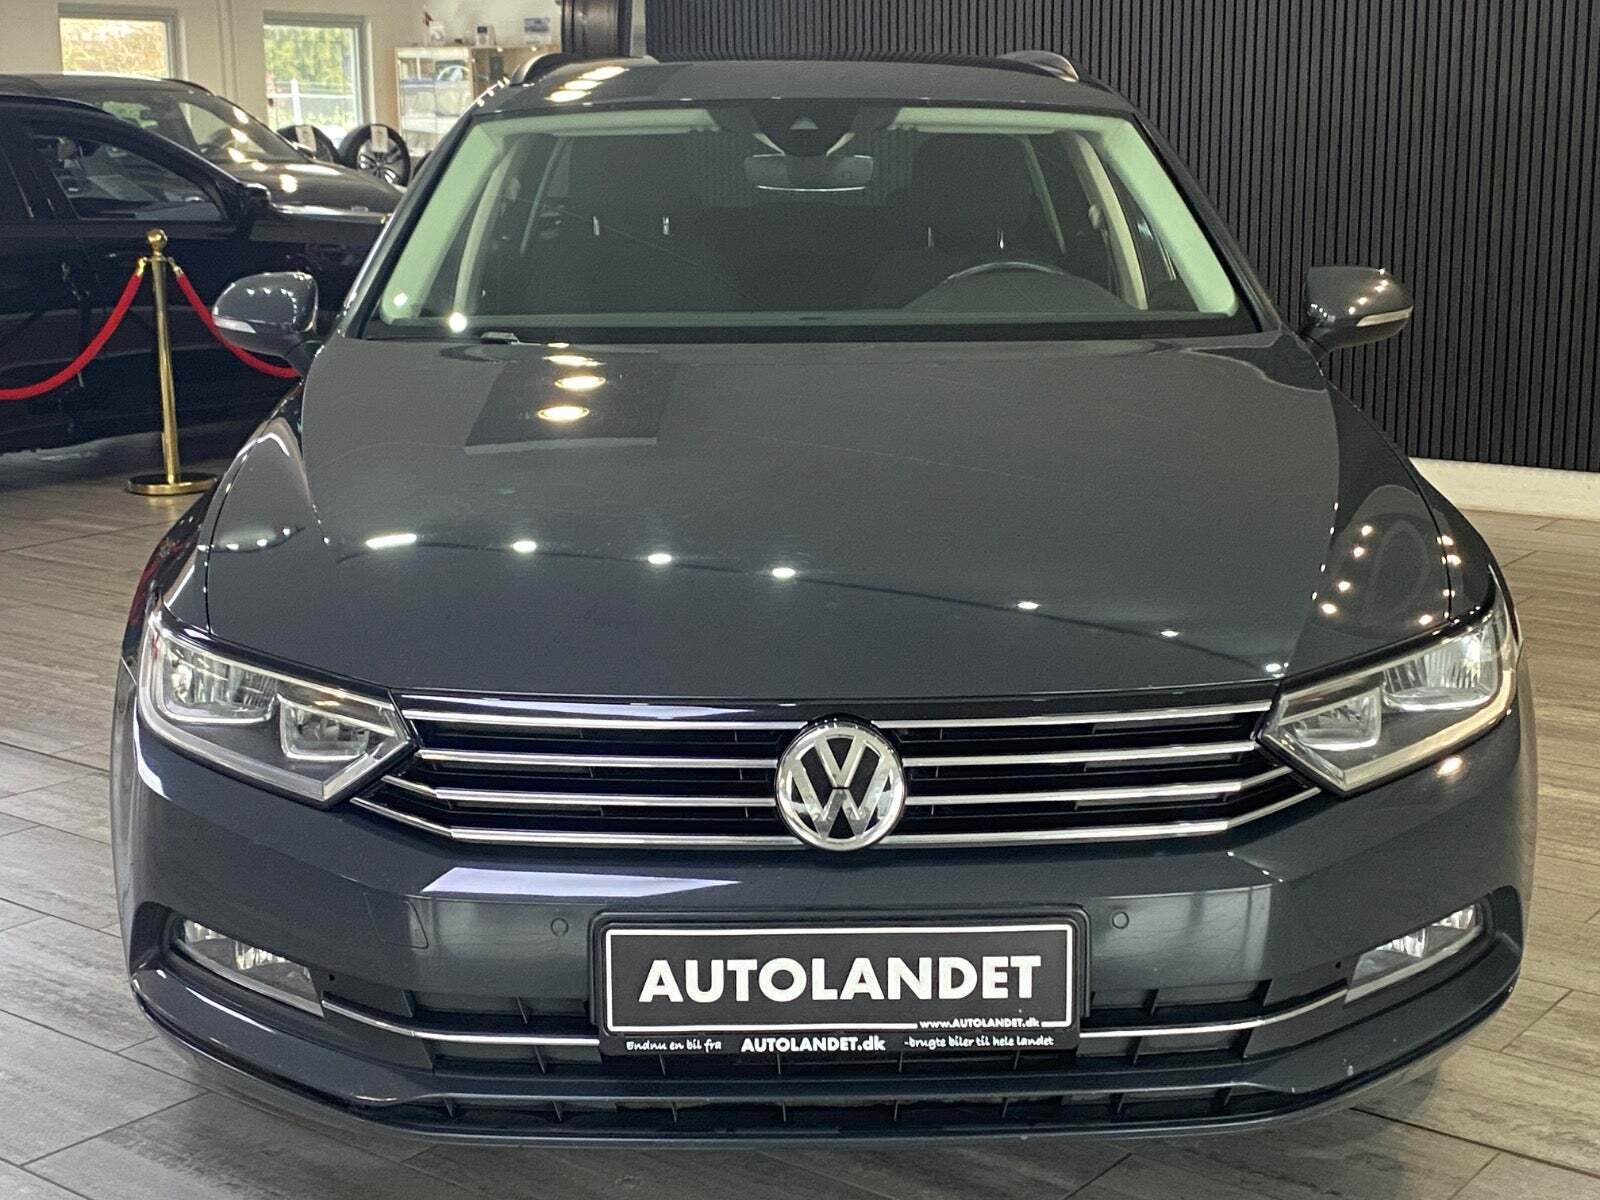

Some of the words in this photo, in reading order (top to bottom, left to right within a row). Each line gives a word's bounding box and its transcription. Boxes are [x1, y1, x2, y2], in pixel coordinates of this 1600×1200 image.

[638, 955, 1042, 1002] AUTOLANDET
[919, 1017, 1041, 1029] www.AUTOLANDET.dk
[626, 1039, 667, 1051] Endnu
[669, 1041, 684, 1051] en
[686, 1038, 702, 1050] bil
[704, 1038, 722, 1053] fra
[740, 1036, 887, 1053] AUTOLANDET.dk
[948, 1035, 975, 1048] biler
[976, 1035, 991, 1047] til
[992, 1035, 1015, 1047] hele
[1016, 1034, 1055, 1047] landet
